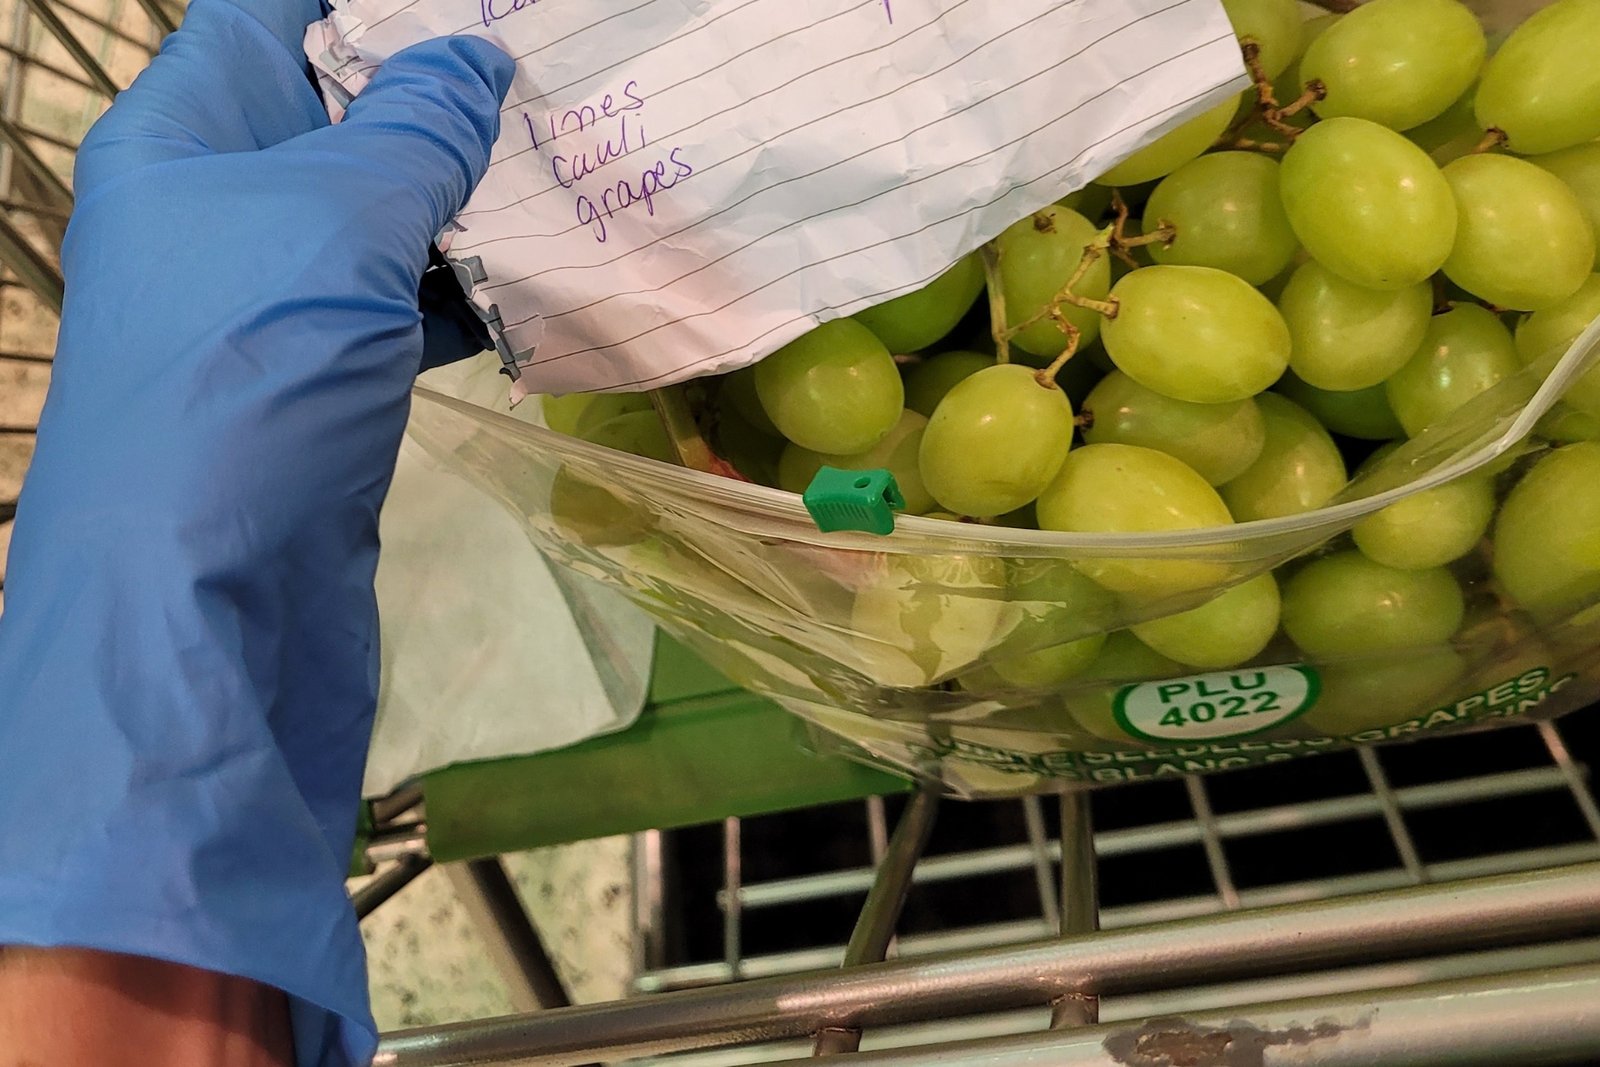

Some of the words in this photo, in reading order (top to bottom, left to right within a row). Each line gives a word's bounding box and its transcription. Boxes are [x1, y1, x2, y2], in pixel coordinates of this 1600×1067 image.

[552, 113, 646, 188] cauli
[576, 147, 692, 243] grapes
[1157, 671, 1267, 703] PLU
[1158, 690, 1281, 727] 4022
[1350, 667, 1549, 743] GRAPES
